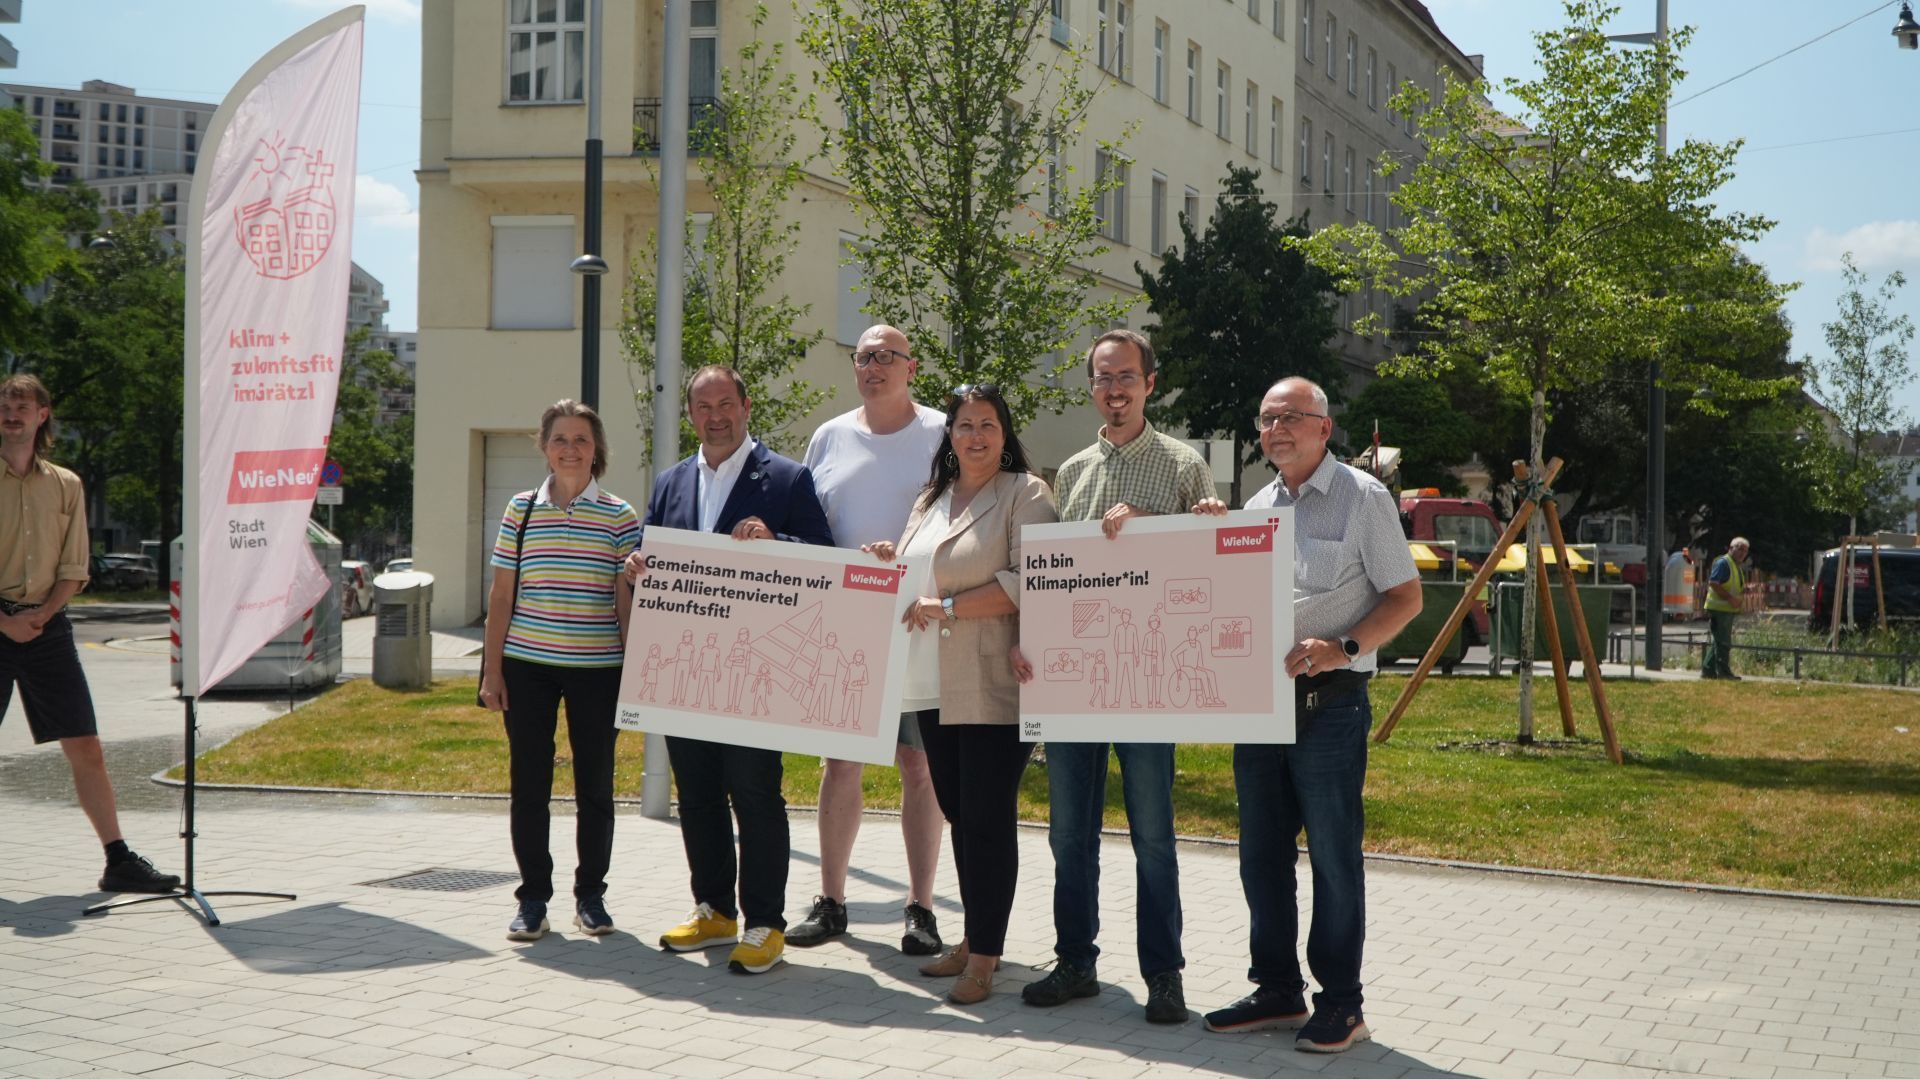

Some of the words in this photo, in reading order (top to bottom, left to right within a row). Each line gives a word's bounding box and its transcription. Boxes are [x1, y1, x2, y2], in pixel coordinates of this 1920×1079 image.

[228, 519, 265, 534] Stadt
[229, 535, 268, 550] Wien
[1026, 554, 1047, 570] Ich
[1050, 552, 1074, 569] bin
[645, 554, 737, 579] Gemeinsam
[740, 569, 802, 587] machen
[805, 575, 833, 590] wir
[641, 575, 669, 591] das
[672, 578, 799, 607] Alliiertenviertel
[638, 596, 731, 619] zukunftsfit!
[621, 717, 639, 726] Wien
[622, 709, 640, 719] Stadt
[1024, 721, 1041, 729] Stadt
[1024, 729, 1042, 737] Wien
